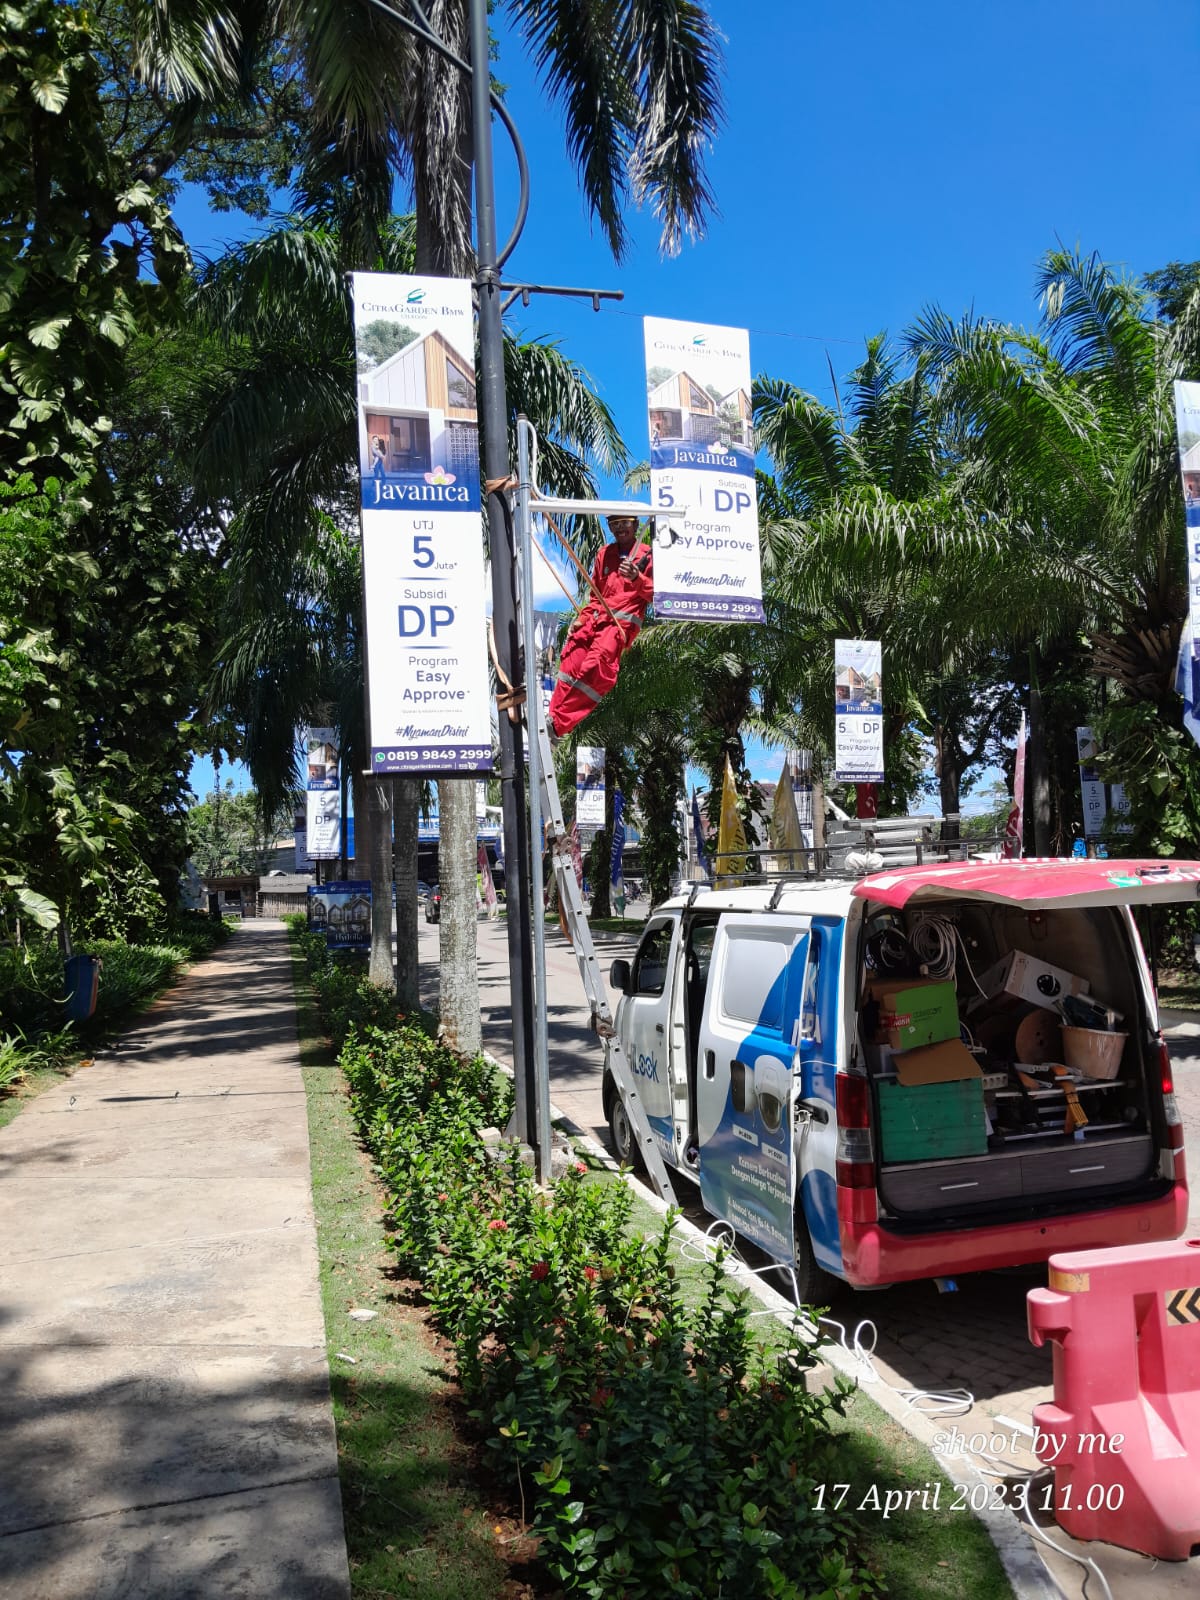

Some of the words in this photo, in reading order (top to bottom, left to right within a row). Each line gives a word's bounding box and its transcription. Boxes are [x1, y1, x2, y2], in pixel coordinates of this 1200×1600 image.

[673, 447, 738, 468] Javanica
[373, 479, 470, 504] Javanica
[658, 486, 675, 508] 5
[412, 520, 434, 530] UTJ
[684, 520, 731, 535] Program
[412, 535, 436, 569] 5
[403, 588, 448, 600] Subsidi
[673, 600, 699, 609] 0819
[701, 601, 729, 611] 9849
[408, 655, 459, 669] Program
[416, 670, 451, 685] Easy
[863, 722, 880, 734] DP
[387, 750, 419, 761] 0819
[422, 749, 457, 760] 9849
[460, 749, 492, 760] 2999
